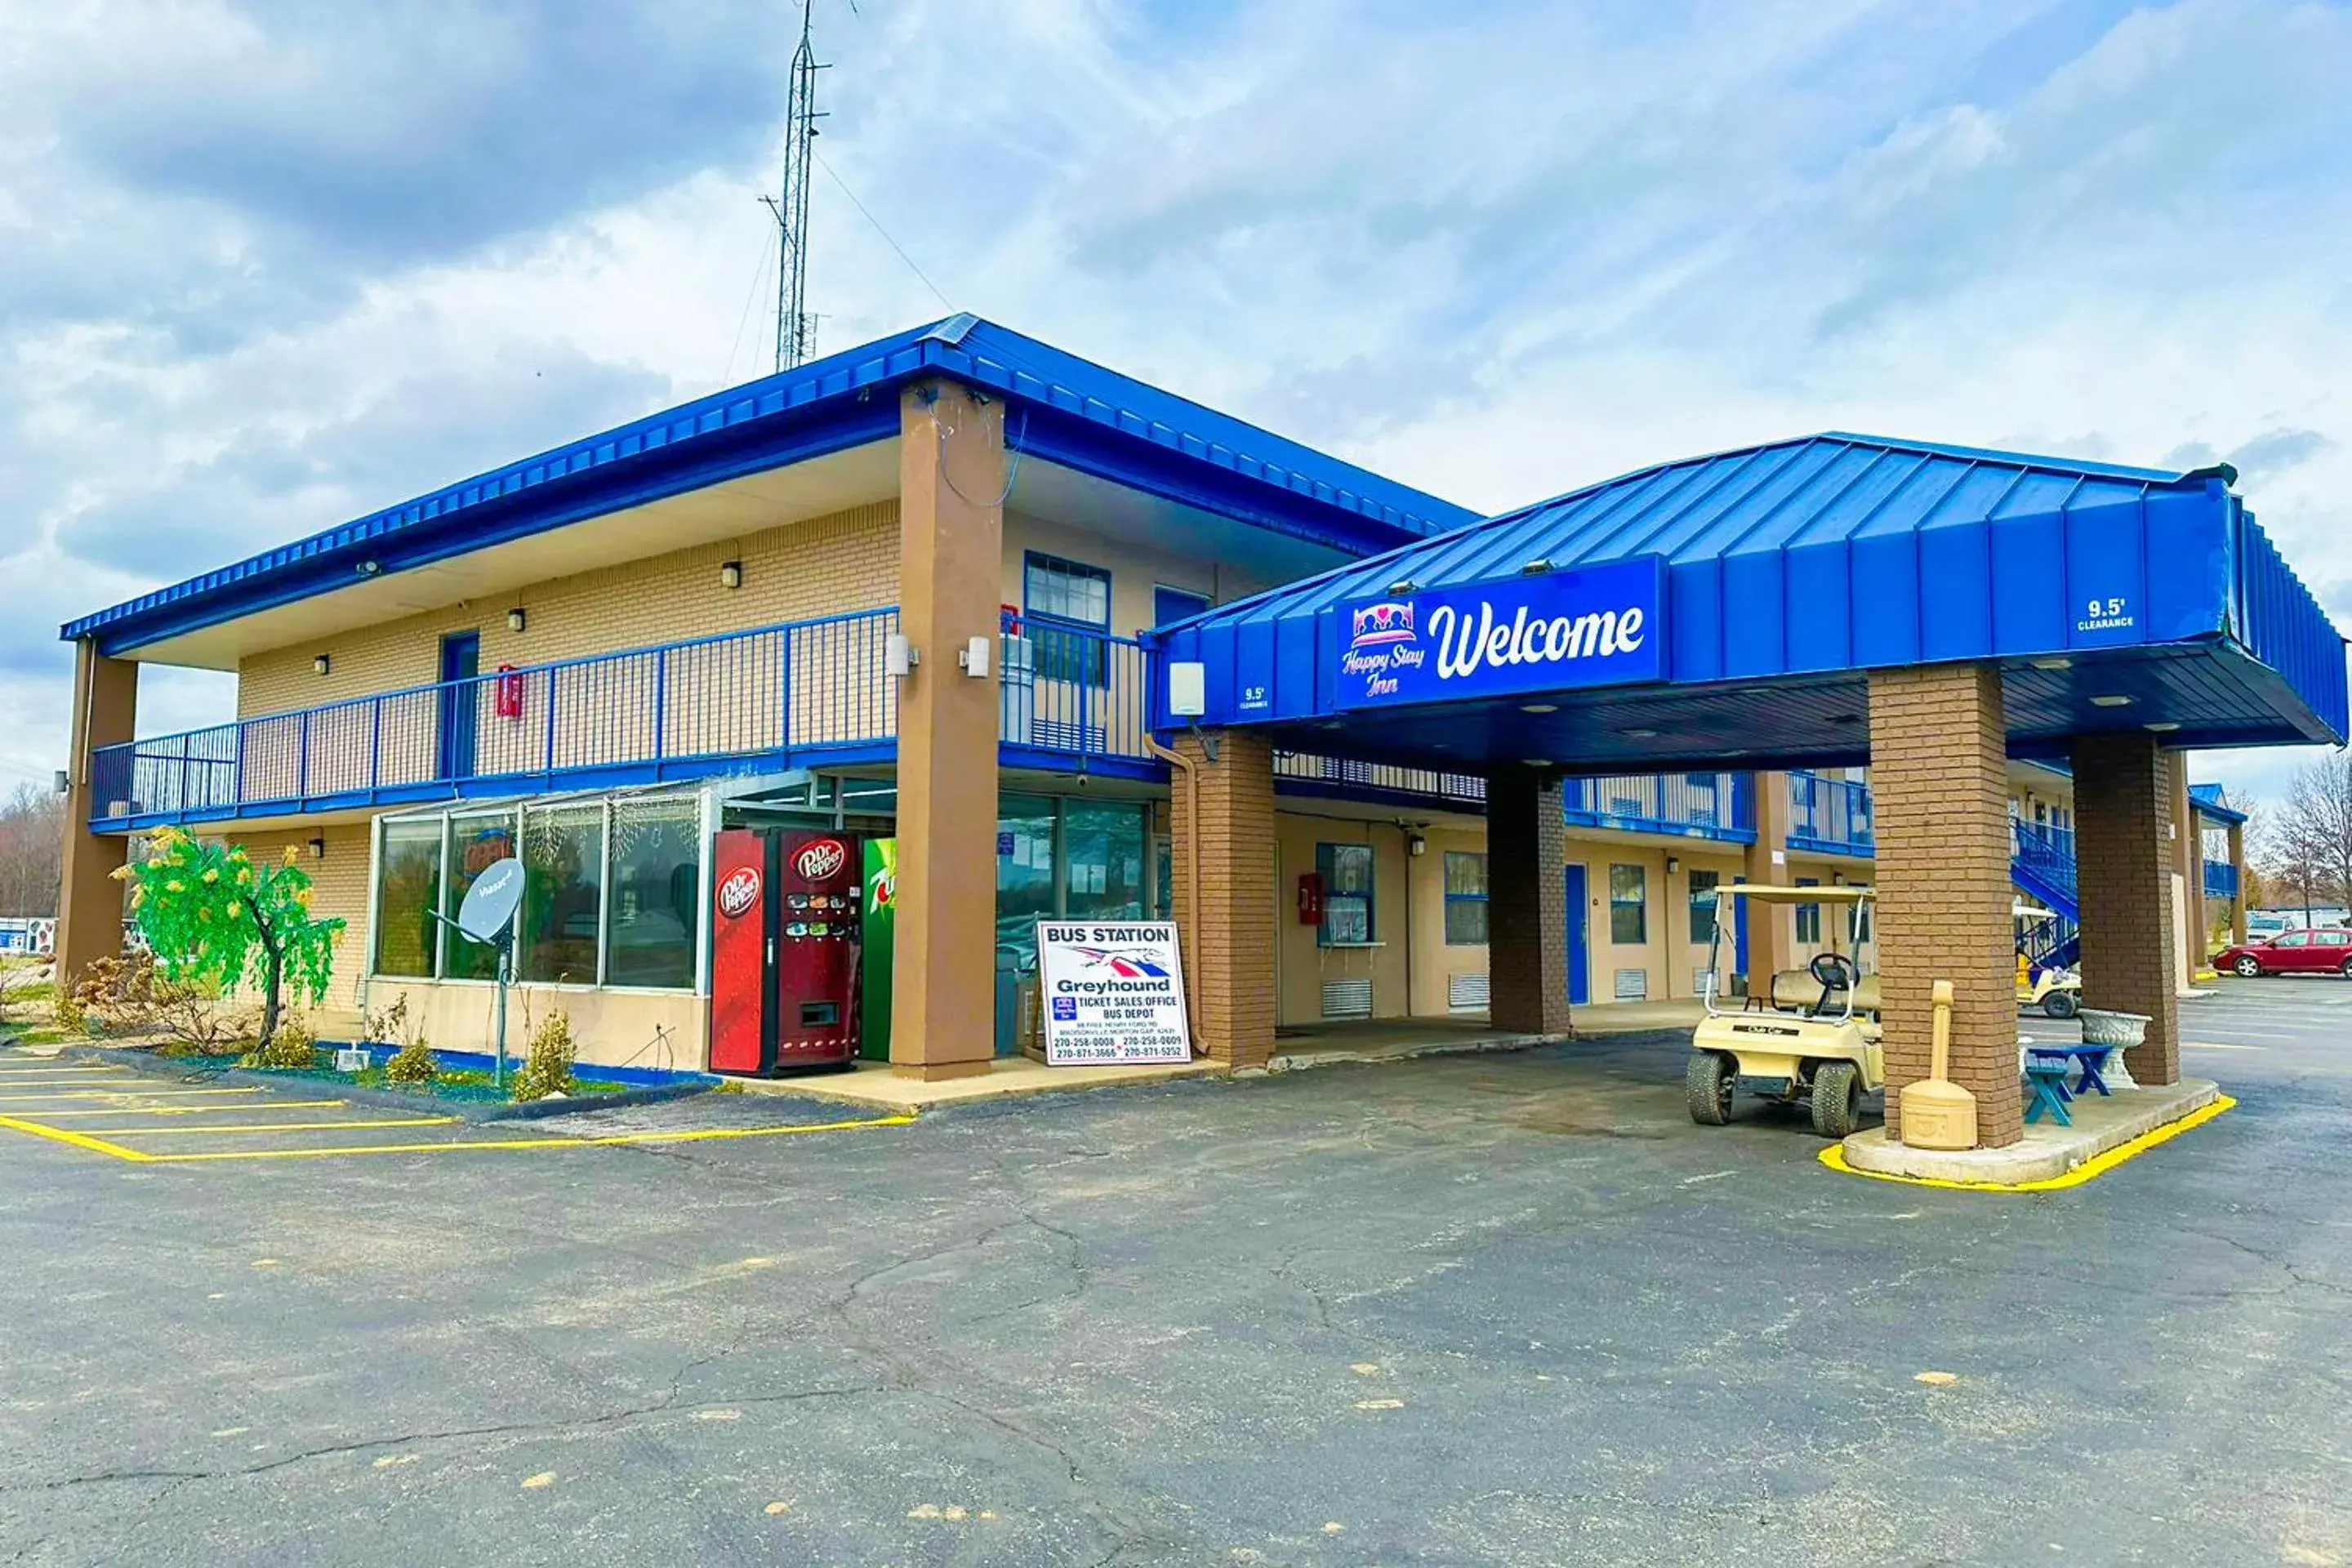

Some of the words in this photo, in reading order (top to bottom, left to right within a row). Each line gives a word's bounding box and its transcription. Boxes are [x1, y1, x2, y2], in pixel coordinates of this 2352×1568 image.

[2087, 598, 2126, 618] 9.5'
[2077, 617, 2133, 631] CLEARANCE
[1428, 601, 1644, 679] Welcome
[1342, 649, 1390, 675] Happy
[1390, 644, 1425, 669] Stay
[1366, 671, 1398, 697] Inn
[1245, 687, 1265, 701] 9.5'
[815, 844, 831, 862] Dr
[798, 849, 842, 878] Pepper
[721, 880, 756, 911] Pepper
[870, 866, 896, 915] 7U
[1047, 928, 1086, 942] BUS
[1093, 928, 1169, 942] STATION
[1057, 979, 1170, 995] Greyhound
[1079, 996, 1111, 1007] TICKET
[1114, 996, 1143, 1007] SALES
[1145, 996, 1178, 1006] OFFICE
[1103, 1009, 1121, 1019] BUS
[1125, 1009, 1154, 1018] DEPOT
